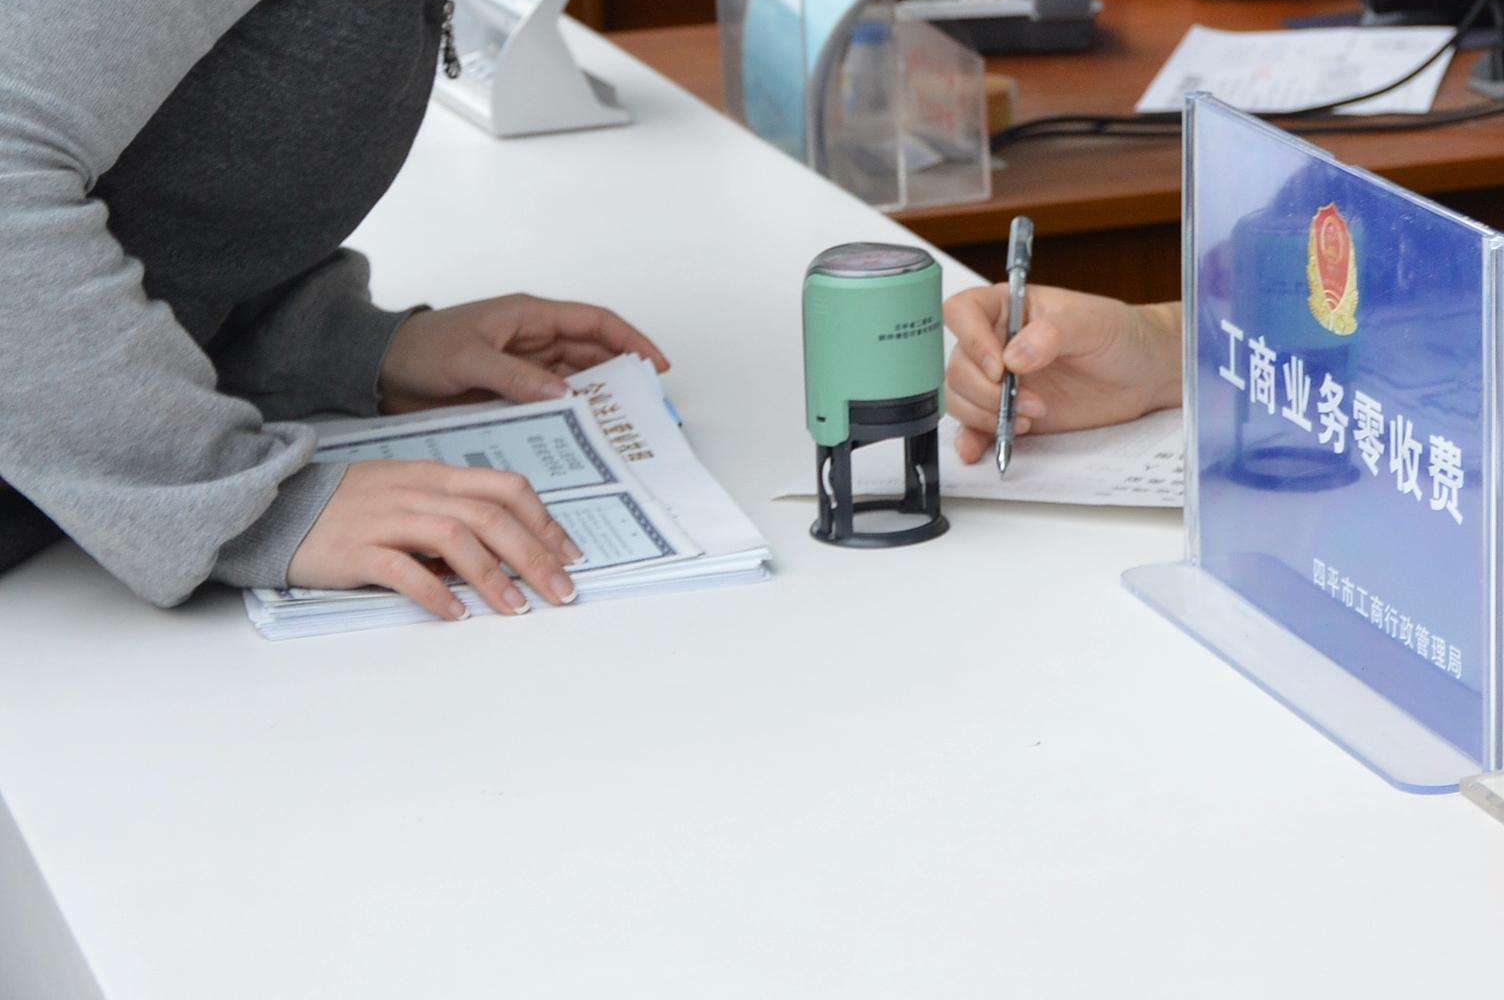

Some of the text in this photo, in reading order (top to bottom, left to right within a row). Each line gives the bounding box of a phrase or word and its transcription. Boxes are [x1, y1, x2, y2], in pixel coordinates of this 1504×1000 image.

[1219, 319, 1464, 525] 工商业务零收费
[1312, 558, 1463, 680] 四平市工商行政管理局
